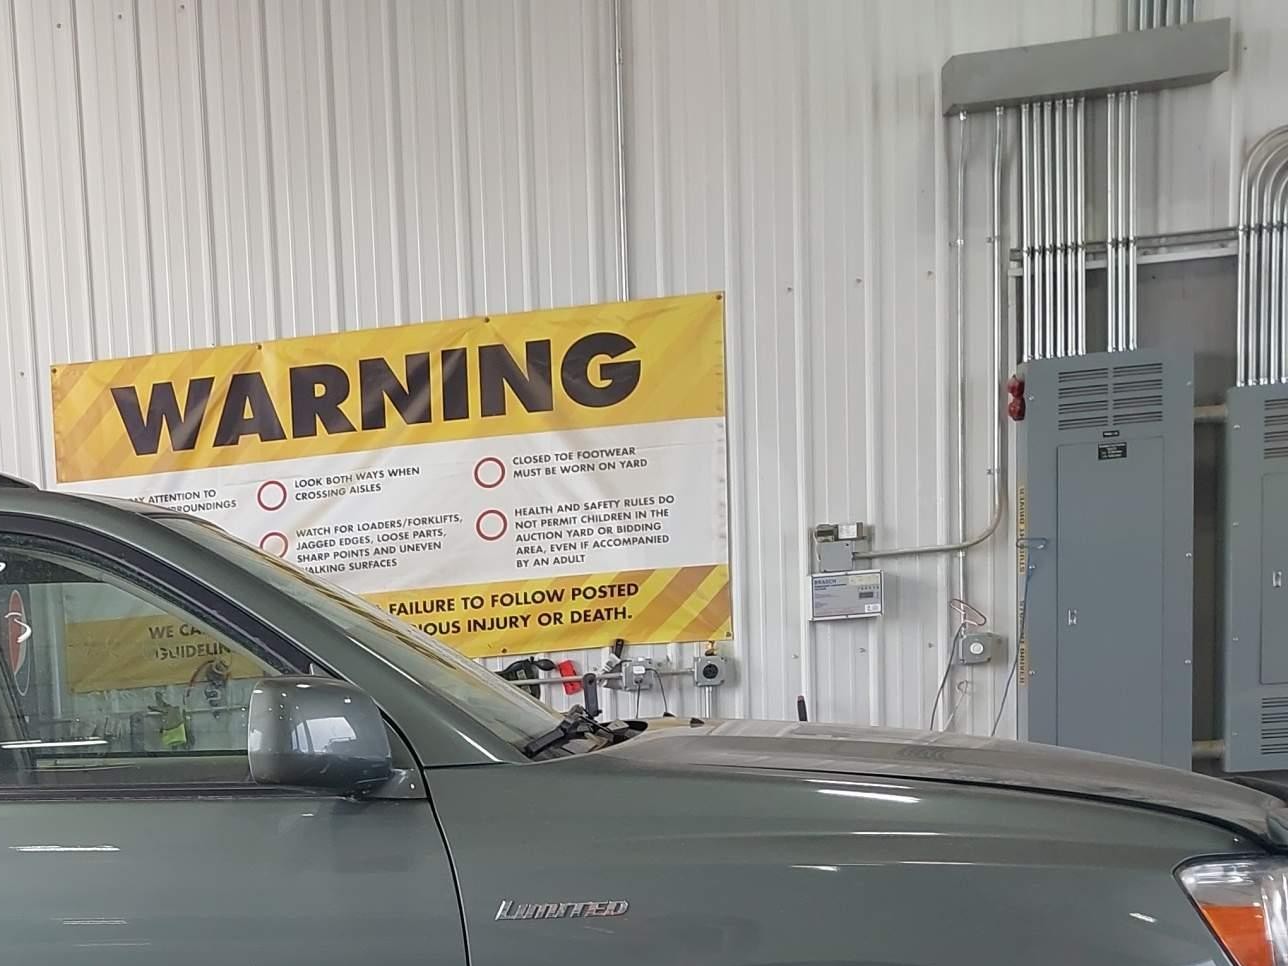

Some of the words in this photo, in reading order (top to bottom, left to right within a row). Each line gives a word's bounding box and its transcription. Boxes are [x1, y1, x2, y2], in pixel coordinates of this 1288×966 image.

[110, 333, 641, 456] WARNING
[512, 454, 551, 465] CLOSED
[554, 452, 574, 462] TOE
[577, 447, 636, 460] FOOTWEAR
[294, 477, 323, 489] LOOK
[326, 475, 353, 485] BOTH
[356, 471, 385, 481] WAYS
[388, 467, 420, 477] WHEN
[513, 467, 541, 479] MUST
[545, 465, 557, 475] BE
[560, 462, 595, 474] WORN
[598, 462, 616, 471] ON
[619, 459, 648, 470] YARD
[148, 491, 201, 504] ATTENTION
[203, 489, 217, 499] TO
[295, 488, 347, 501] CROSSING
[349, 483, 382, 494] AISLES
[515, 506, 553, 517] HEALTH
[557, 503, 581, 514] AND
[583, 499, 621, 511] SAFETY
[624, 496, 655, 508] RULES
[658, 495, 675, 504] DO
[296, 526, 331, 538] WATCH
[334, 524, 354, 534] FOR
[357, 513, 463, 532] LOADERS/FORKLIFTS,
[515, 519, 538, 530] NOT
[541, 516, 577, 528] PERMIT
[580, 511, 632, 524] CHILDREN
[635, 510, 647, 519] IN
[650, 508, 669, 518] THE
[296, 538, 336, 551] JAGGED
[339, 535, 374, 547] EDGES,
[377, 531, 409, 543] LOOSE
[412, 528, 447, 540] PARTS,
[516, 530, 563, 542] AUCTION
[566, 527, 594, 539] YARD
[597, 525, 614, 535] OR
[616, 522, 662, 534] BIDDING
[297, 551, 330, 563] SHARP
[333, 548, 370, 560] POINTS
[373, 545, 396, 556] AND
[399, 541, 442, 553] UNEVEN
[516, 545, 547, 556] AREA,
[550, 541, 577, 552] EVEN
[580, 540, 589, 550] IF
[592, 534, 670, 549] ACCOMPANIED
[349, 559, 398, 571] SURFACES
[516, 559, 530, 569] BY
[533, 557, 550, 567] AN
[553, 554, 586, 565] ADULT
[148, 625, 174, 640] WE
[388, 598, 455, 616] FAILURE
[461, 596, 484, 610] TO
[490, 589, 564, 608] FOLLOW
[571, 583, 639, 601] POSTED
[467, 614, 531, 633] INJURY
[537, 611, 563, 627] OR
[570, 606, 632, 625] DEATH.
